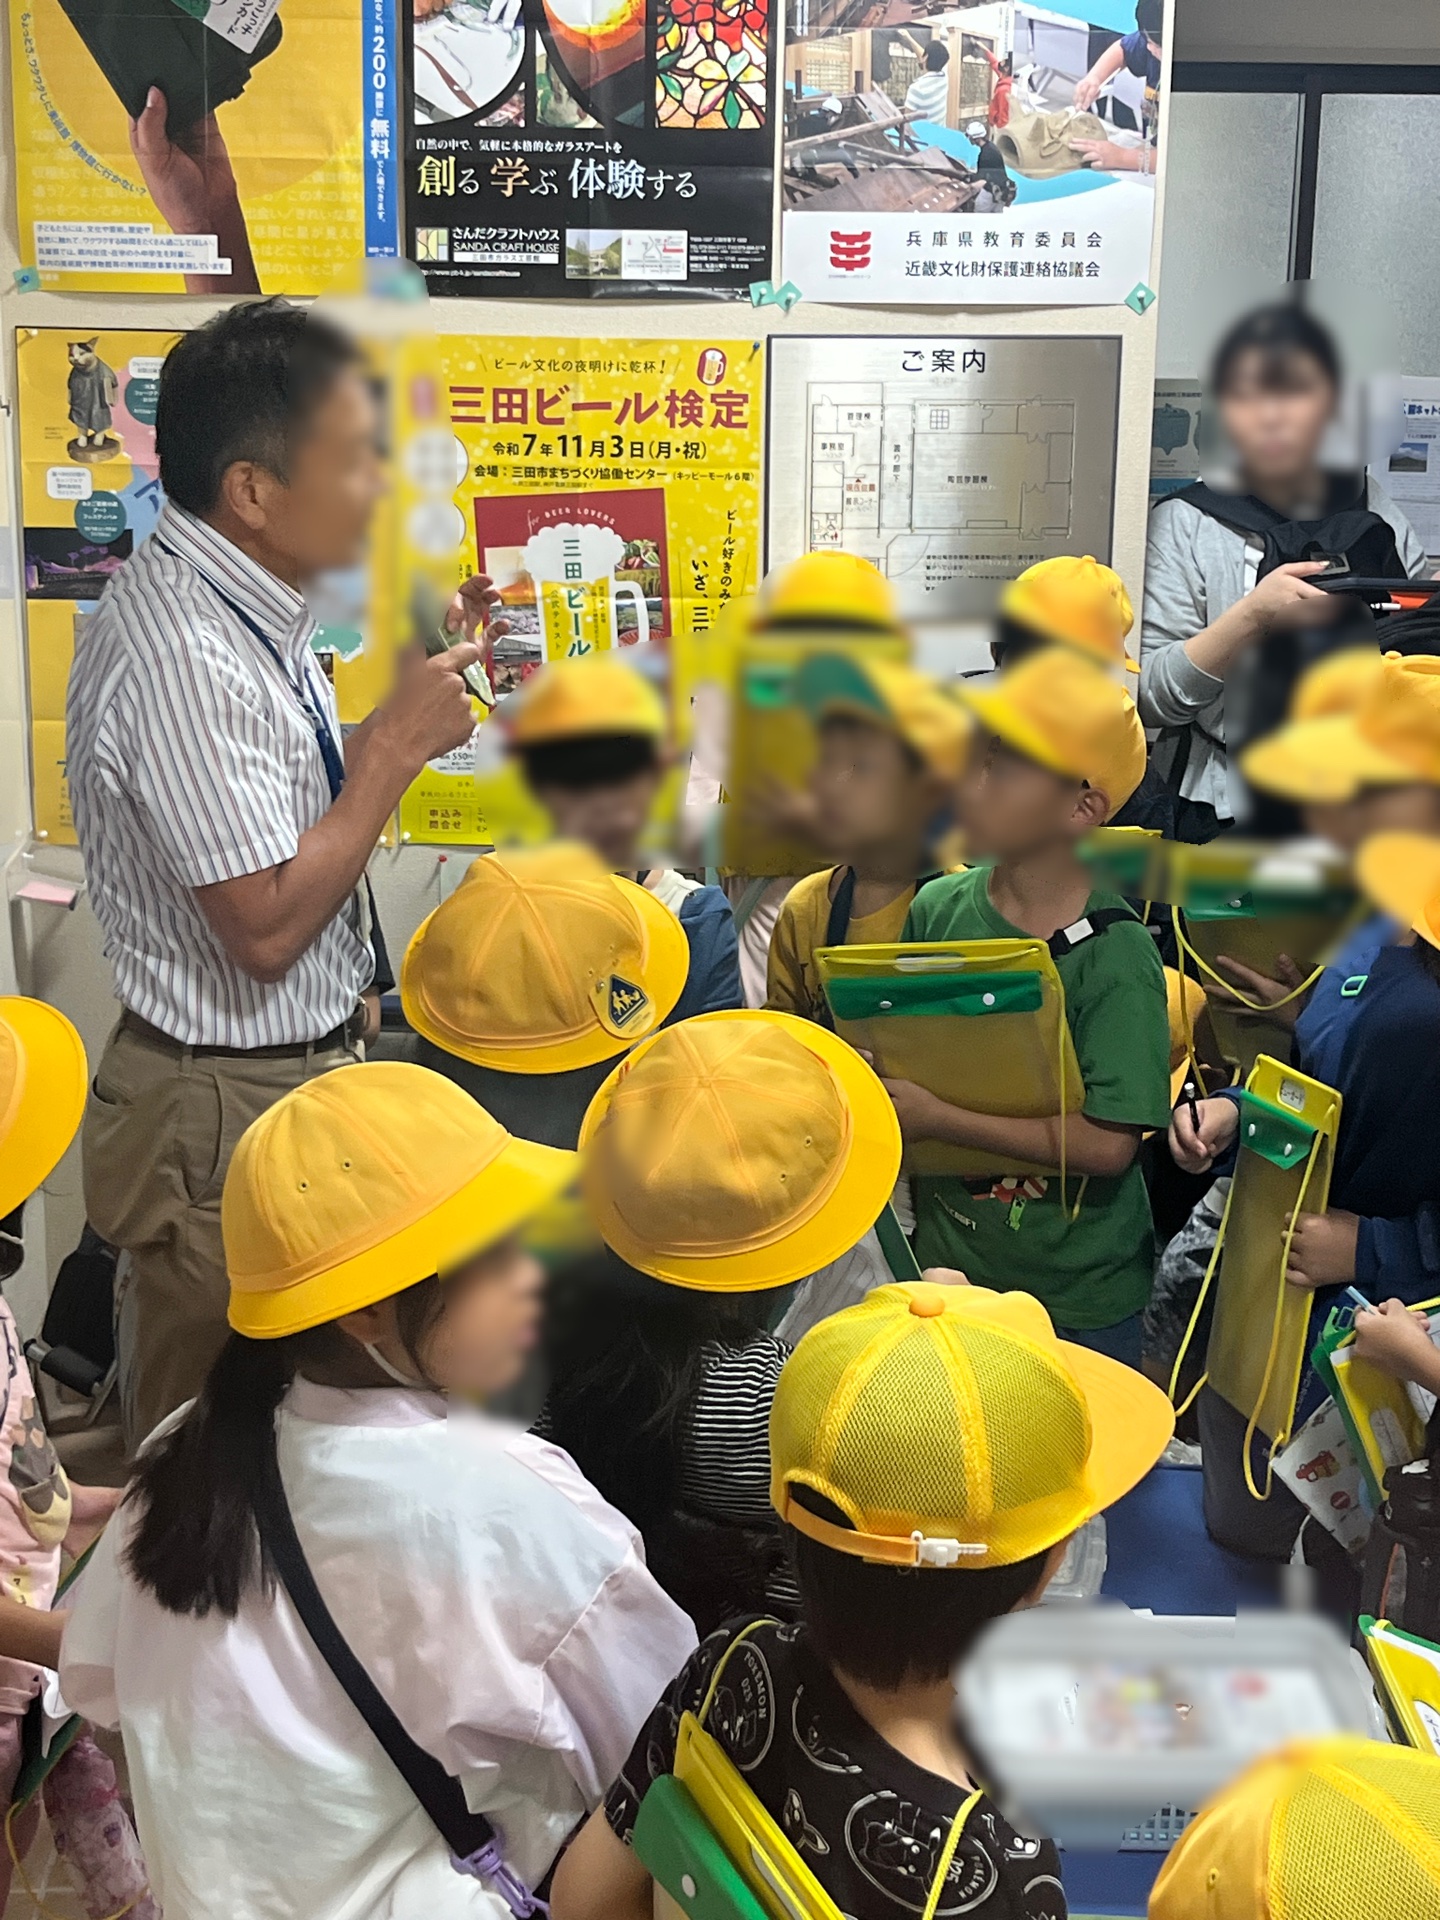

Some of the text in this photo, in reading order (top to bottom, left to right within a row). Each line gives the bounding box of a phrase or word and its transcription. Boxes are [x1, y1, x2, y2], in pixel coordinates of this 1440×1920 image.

[418, 155, 698, 200] 創る 学ぶ 体験する
[452, 227, 561, 241] さんだクラフトハウス
[905, 230, 1102, 248] 兵庫県教育委員会
[453, 242, 560, 254] SANDA CRAFT HOUSE
[905, 260, 1101, 278] 近畿文化財保護連絡協議会
[902, 348, 986, 374] ご案内
[449, 385, 750, 430] 三田ビール検定
[544, 506, 571, 519] BEER
[577, 507, 616, 526] LOVERS
[562, 539, 591, 658] 三田ビール
[429, 808, 462, 818] 申込み
[429, 820, 462, 830] 問合せ
